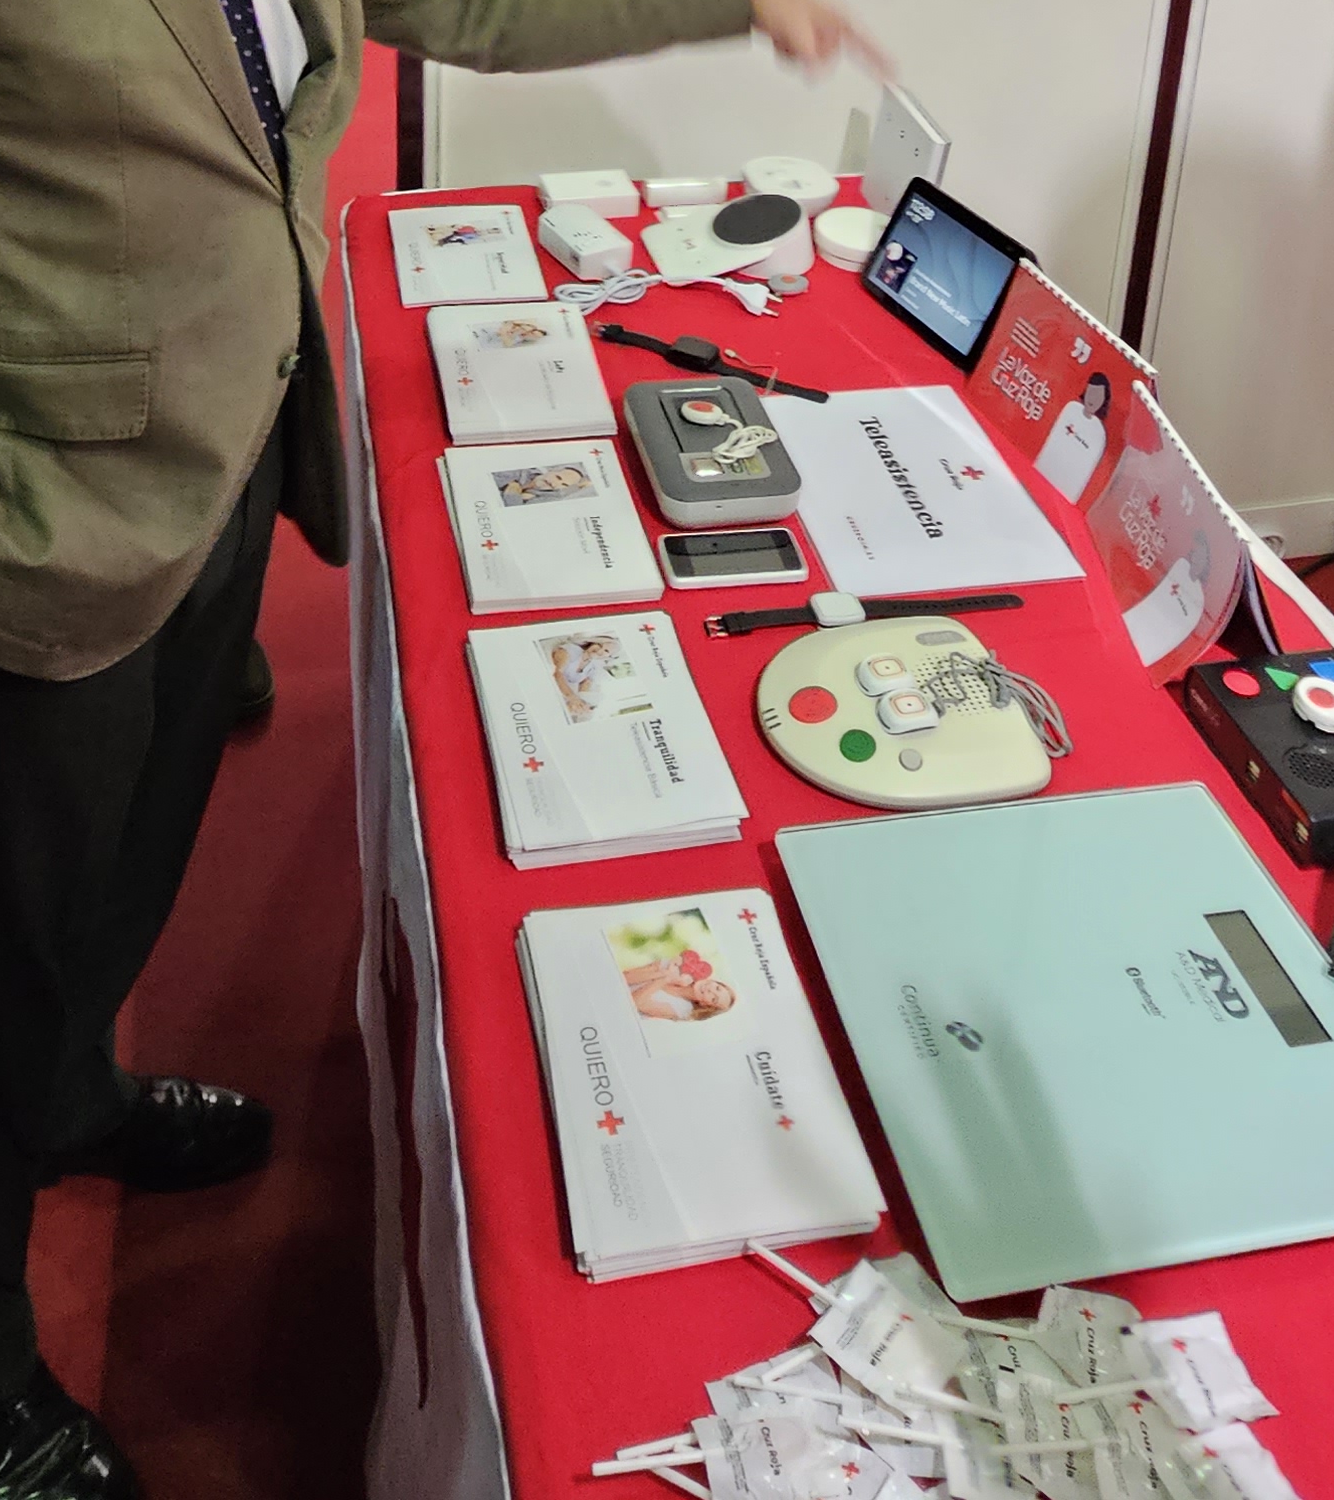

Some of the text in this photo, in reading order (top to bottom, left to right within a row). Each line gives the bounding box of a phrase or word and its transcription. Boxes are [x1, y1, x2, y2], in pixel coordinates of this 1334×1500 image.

[991, 364, 1044, 421] Cruz Roja
[998, 346, 1051, 404] La Voz de
[858, 415, 944, 540] Teleasistencia
[474, 500, 494, 538] QUIERO
[589, 515, 613, 569] Independencia
[510, 702, 537, 754] QUIERO
[649, 718, 684, 784] Tranquilidad
[900, 984, 940, 1058] Continua
[579, 1025, 615, 1107] QUIERO
[1086, 1326, 1100, 1384] Cruz Roja
[760, 1425, 782, 1477] Cruz Roja
[1139, 1420, 1153, 1453] Cruz
